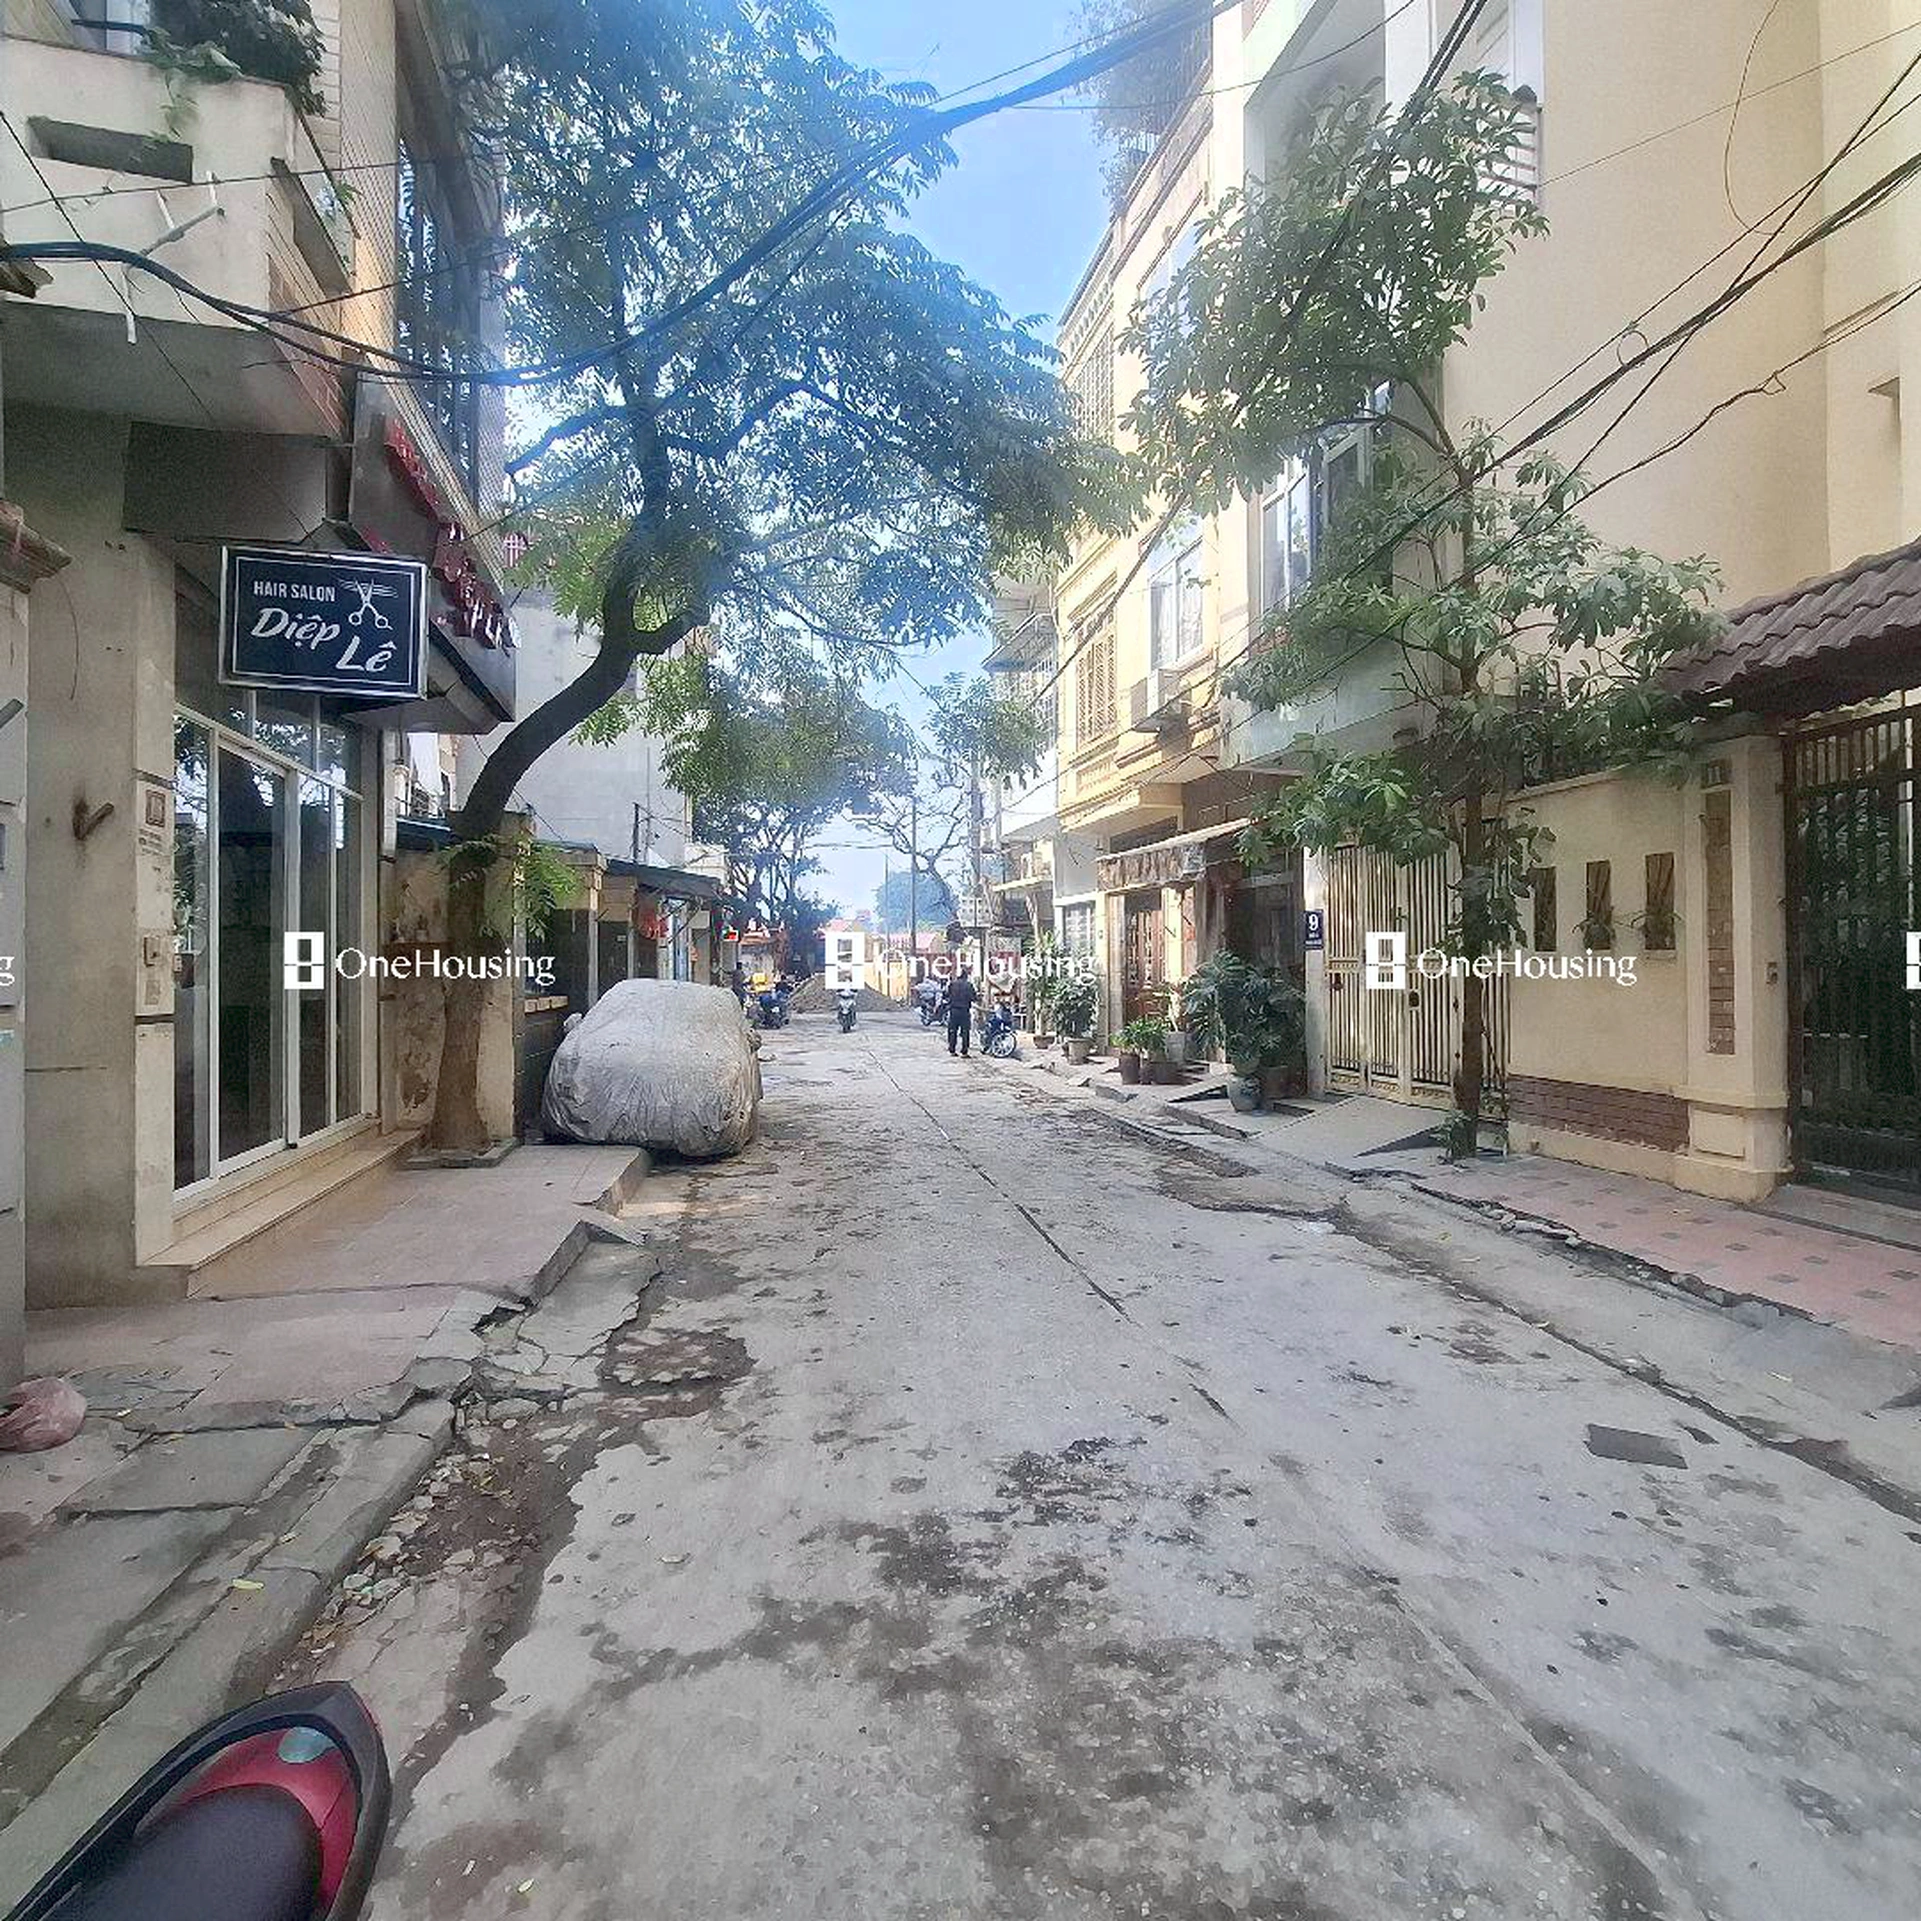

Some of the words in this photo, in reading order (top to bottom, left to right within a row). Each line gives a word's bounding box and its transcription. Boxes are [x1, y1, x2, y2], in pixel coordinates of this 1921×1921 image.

[253, 580, 287, 598] HAIR
[290, 584, 336, 603] SALON
[251, 607, 341, 650] Diệp
[336, 635, 397, 672] Lê
[1308, 913, 1319, 931] 9
